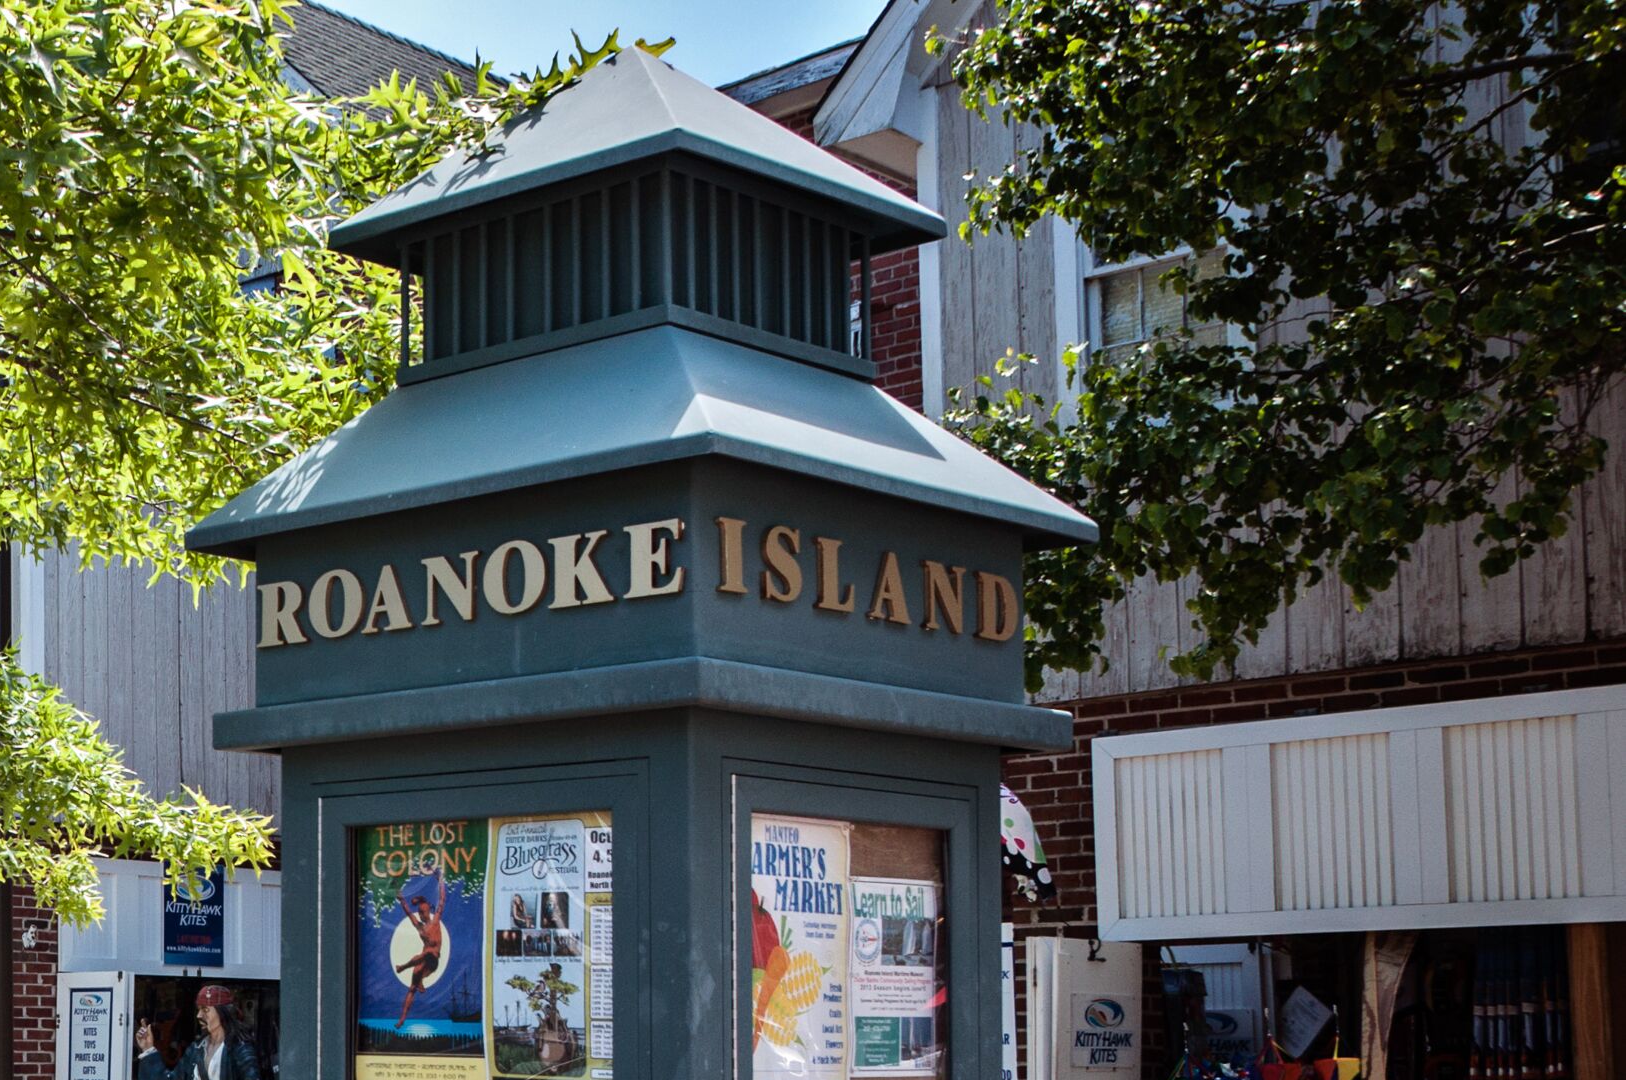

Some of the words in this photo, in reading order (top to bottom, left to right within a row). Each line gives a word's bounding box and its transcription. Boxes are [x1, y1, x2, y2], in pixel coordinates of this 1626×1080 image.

[257, 517, 685, 648] ROANOKE
[715, 516, 1019, 641] ISLAND
[376, 824, 415, 847] THE
[420, 821, 468, 844] LOST
[764, 824, 800, 844] MANTEO
[371, 846, 477, 877] COLONY
[502, 842, 577, 872] Bluegrass
[774, 879, 843, 915] MARKET
[852, 883, 887, 918] Learn
[890, 888, 903, 919] to
[905, 886, 924, 920] Sail
[166, 901, 191, 913] KITTY
[192, 902, 222, 916] HAWK
[180, 914, 207, 926] KITES
[84, 1028, 97, 1036] KITES
[1075, 1031, 1102, 1047] KITTY
[1102, 1031, 1134, 1047] HAWK
[84, 1040, 96, 1049] TOYS
[1210, 1038, 1251, 1052] HAWK
[74, 1054, 91, 1062] PIRATE
[92, 1053, 104, 1062] GEAR
[1090, 1048, 1117, 1064] KITES
[82, 1066, 96, 1075] GIFTS
